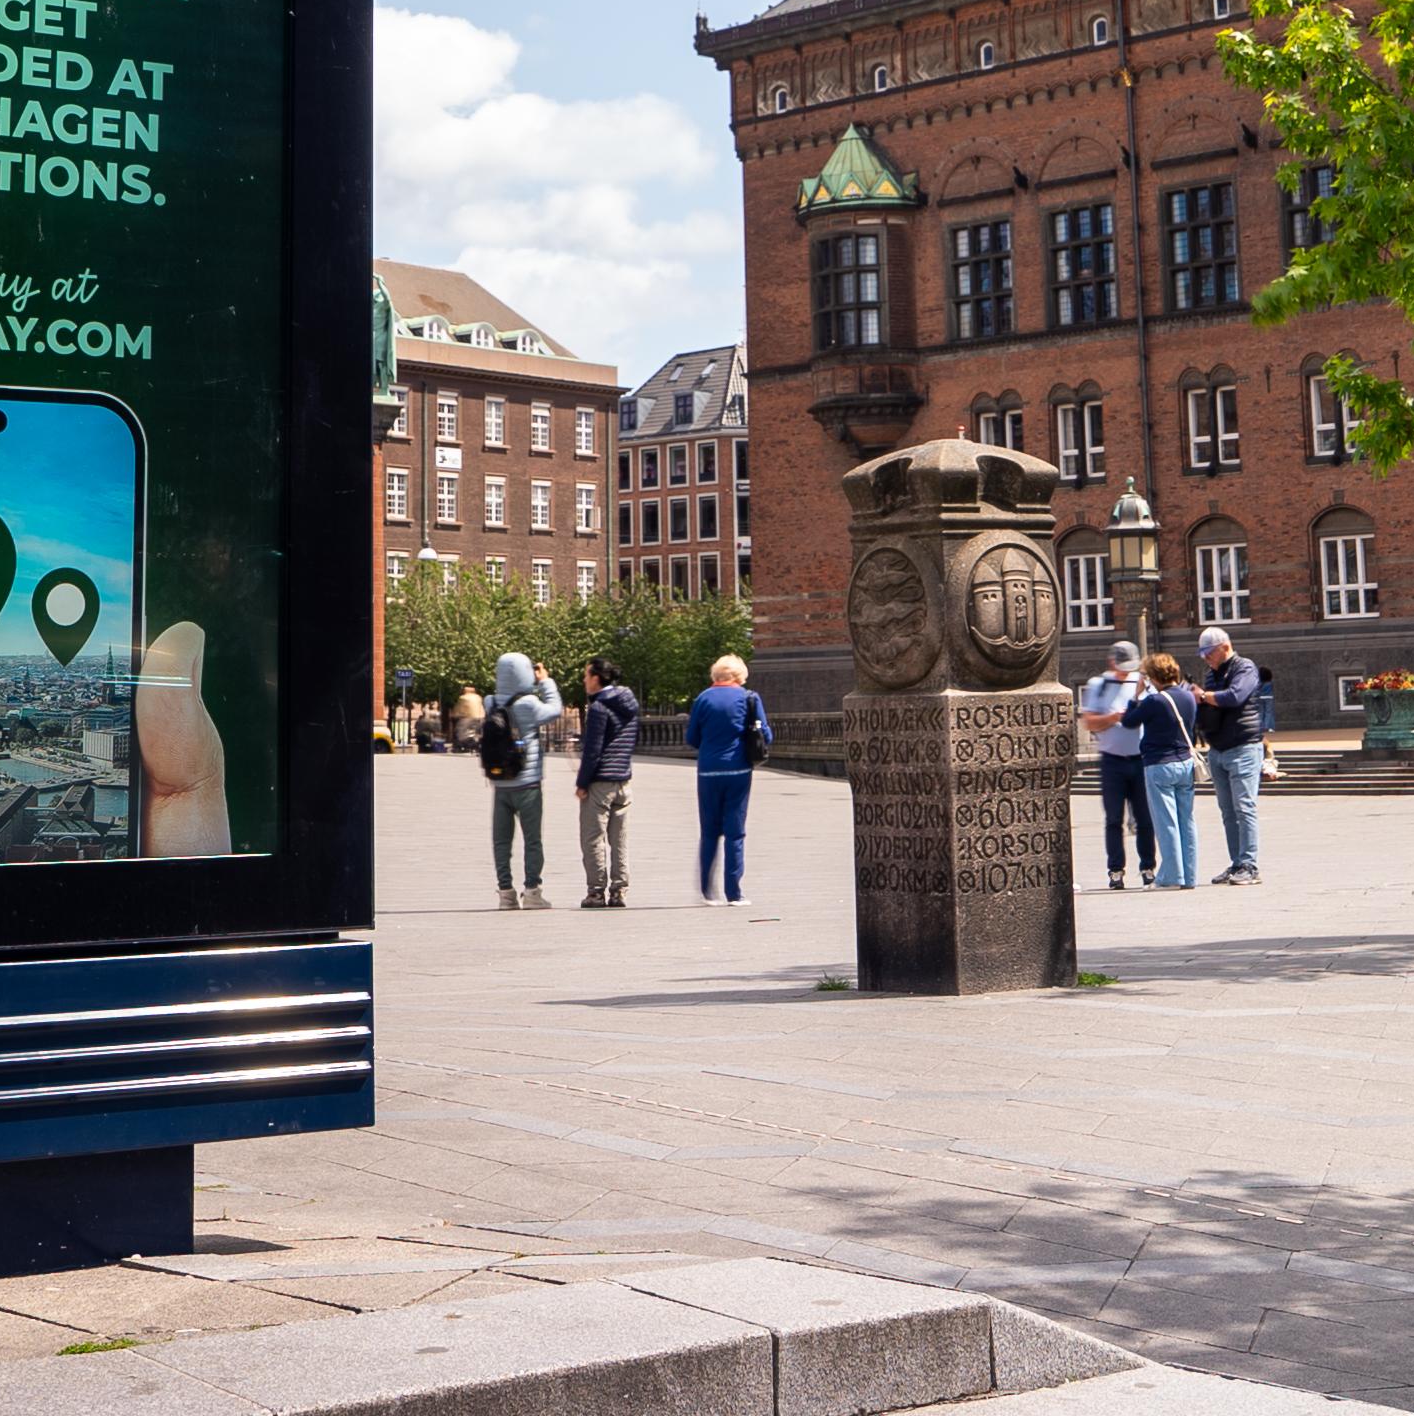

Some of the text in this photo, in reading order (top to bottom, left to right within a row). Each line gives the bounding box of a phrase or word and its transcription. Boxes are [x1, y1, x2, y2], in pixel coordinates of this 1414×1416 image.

[107, 58, 174, 101] AT
[51, 267, 100, 304] at
[956, 702, 1068, 730] ROSKILDE
[956, 766, 1068, 795] RINGSTED
